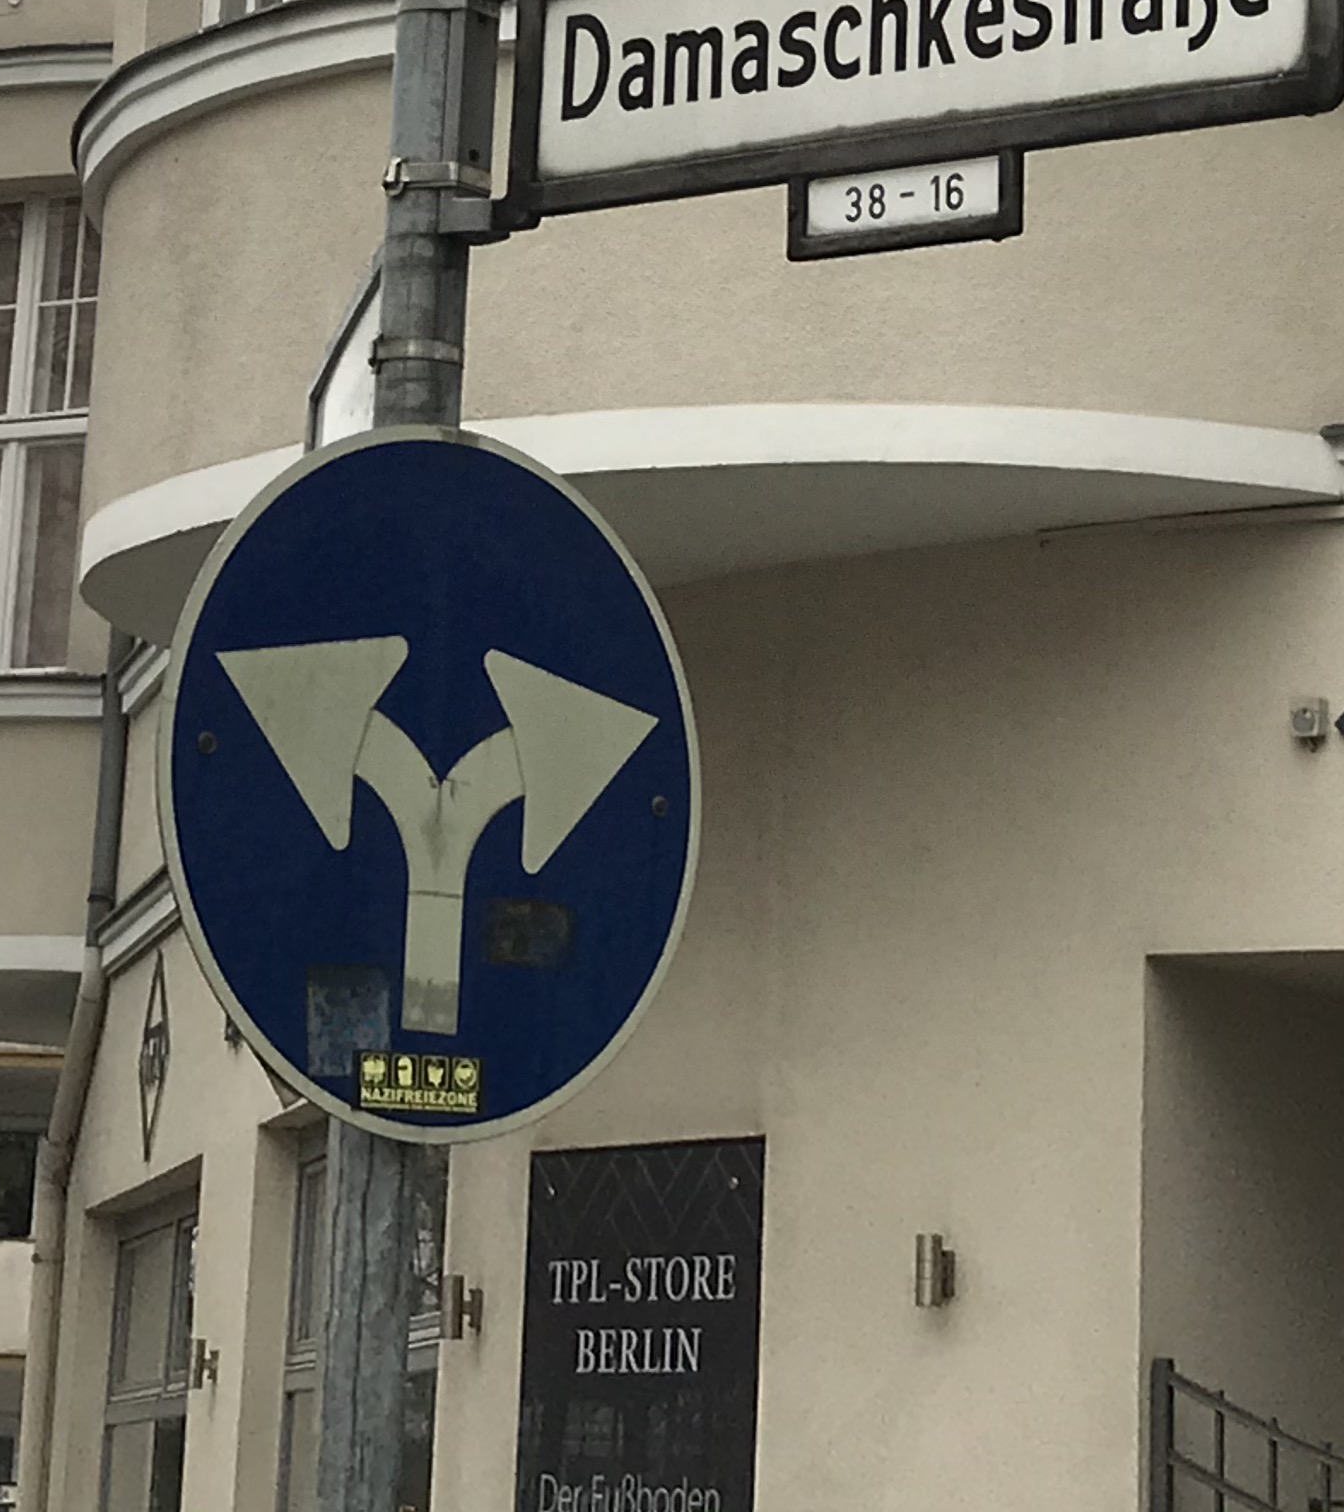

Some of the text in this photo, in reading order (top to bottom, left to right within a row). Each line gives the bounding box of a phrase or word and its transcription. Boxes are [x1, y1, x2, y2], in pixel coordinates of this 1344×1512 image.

[844, 182, 886, 223] 38
[929, 172, 965, 213] 16
[360, 1086, 478, 1107] NAZIFREIEZONE
[548, 1254, 737, 1304] TPL-STORE
[574, 1327, 703, 1374] BERLIN
[537, 1472, 721, 1512] Der Fußboden
